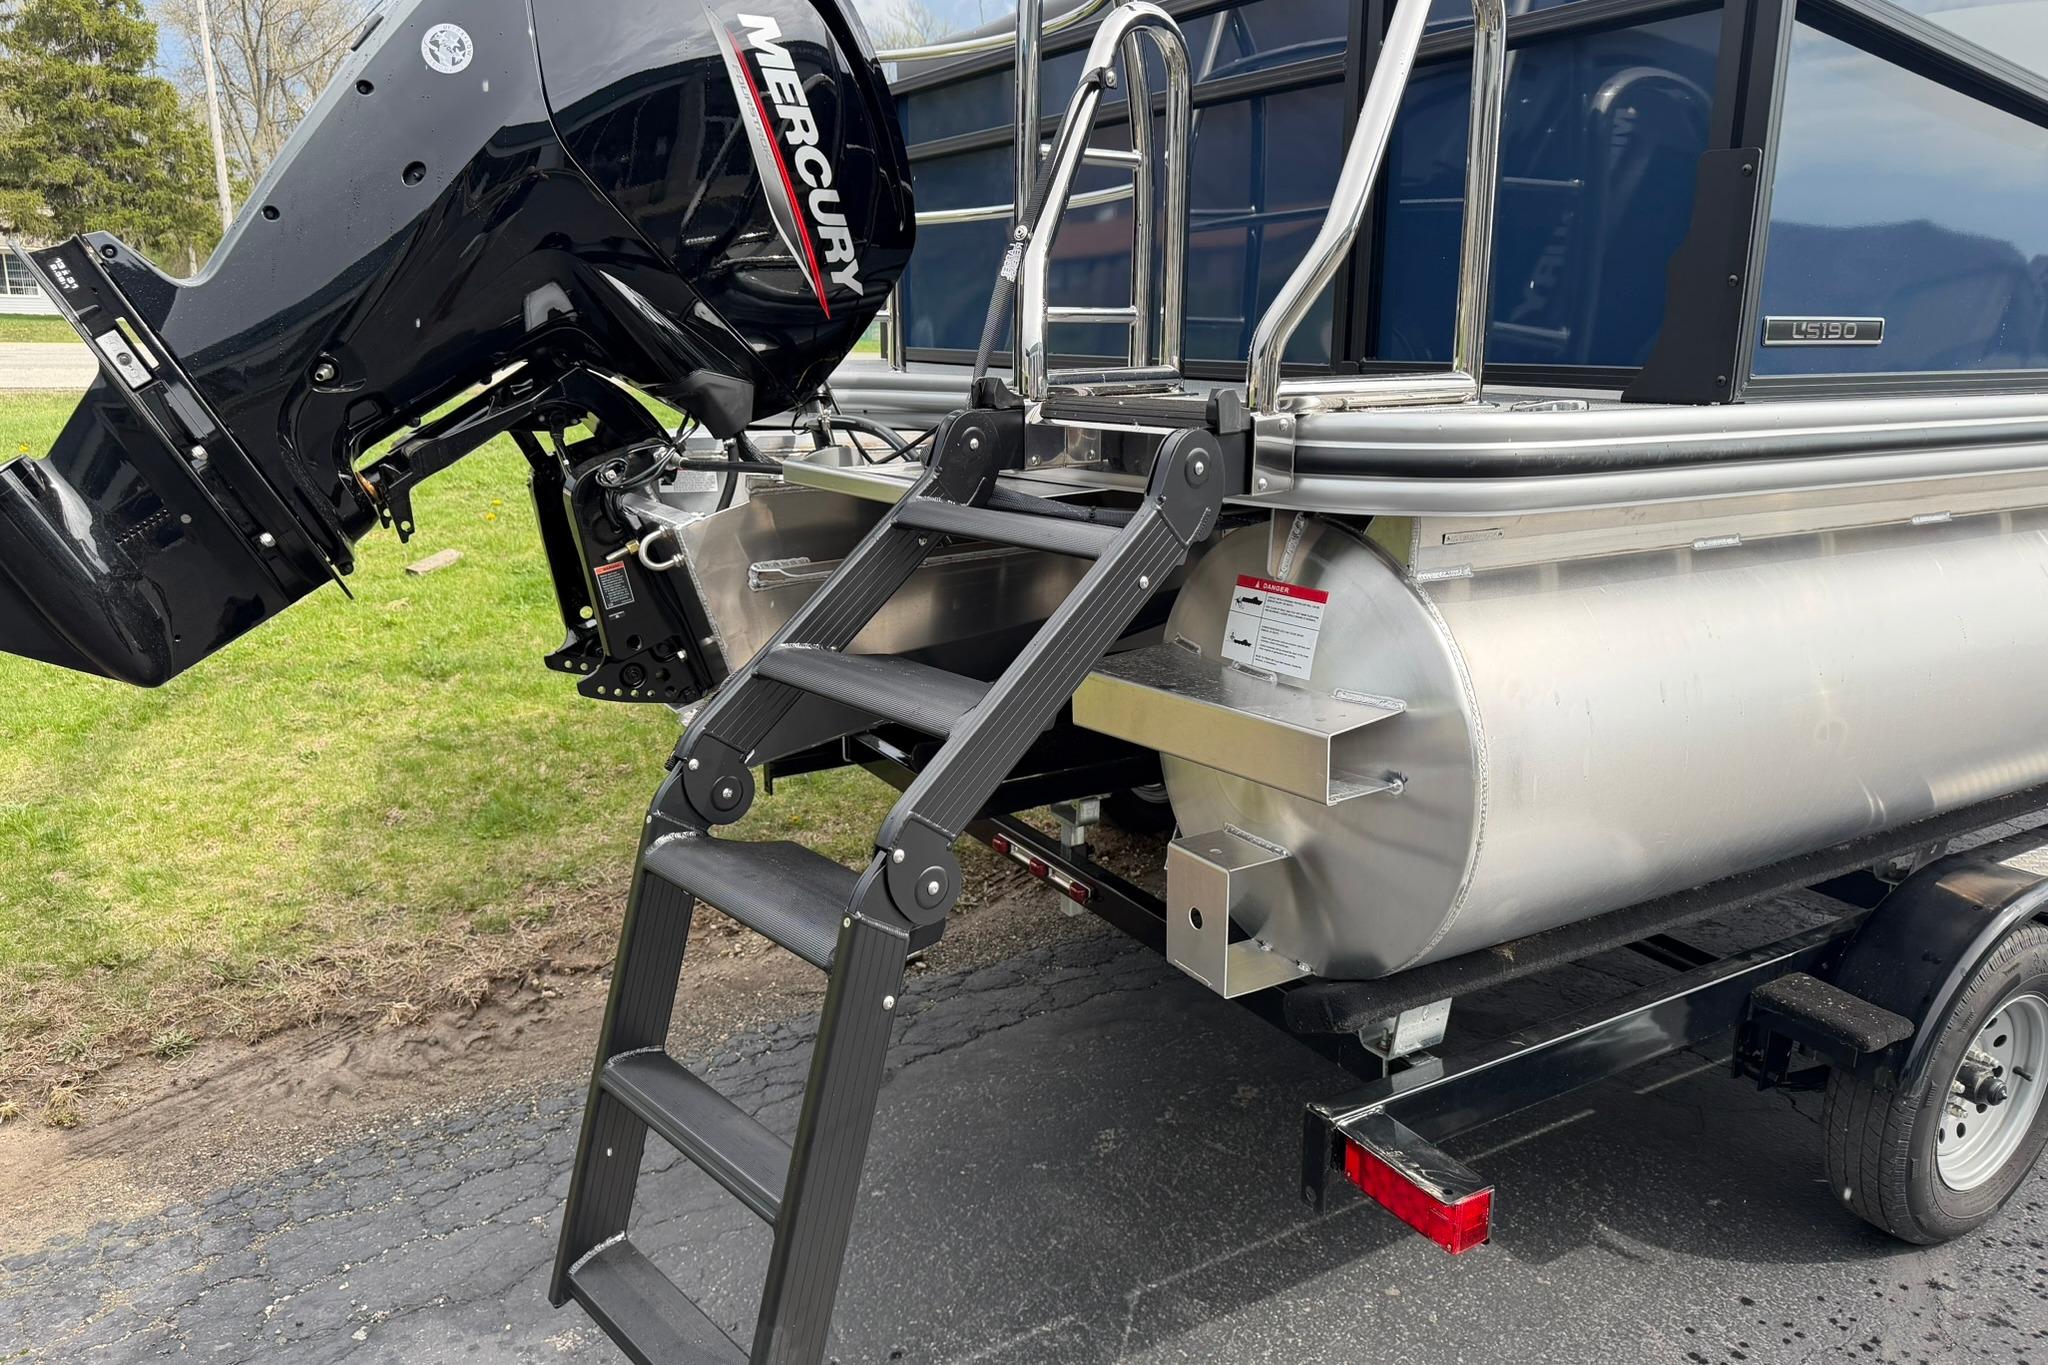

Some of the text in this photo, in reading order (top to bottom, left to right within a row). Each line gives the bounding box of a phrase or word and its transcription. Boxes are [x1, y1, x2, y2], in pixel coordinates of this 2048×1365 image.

[737, 13, 864, 297] MERCURY
[1792, 322, 1857, 339] LS190
[1263, 582, 1290, 594] DANGER
